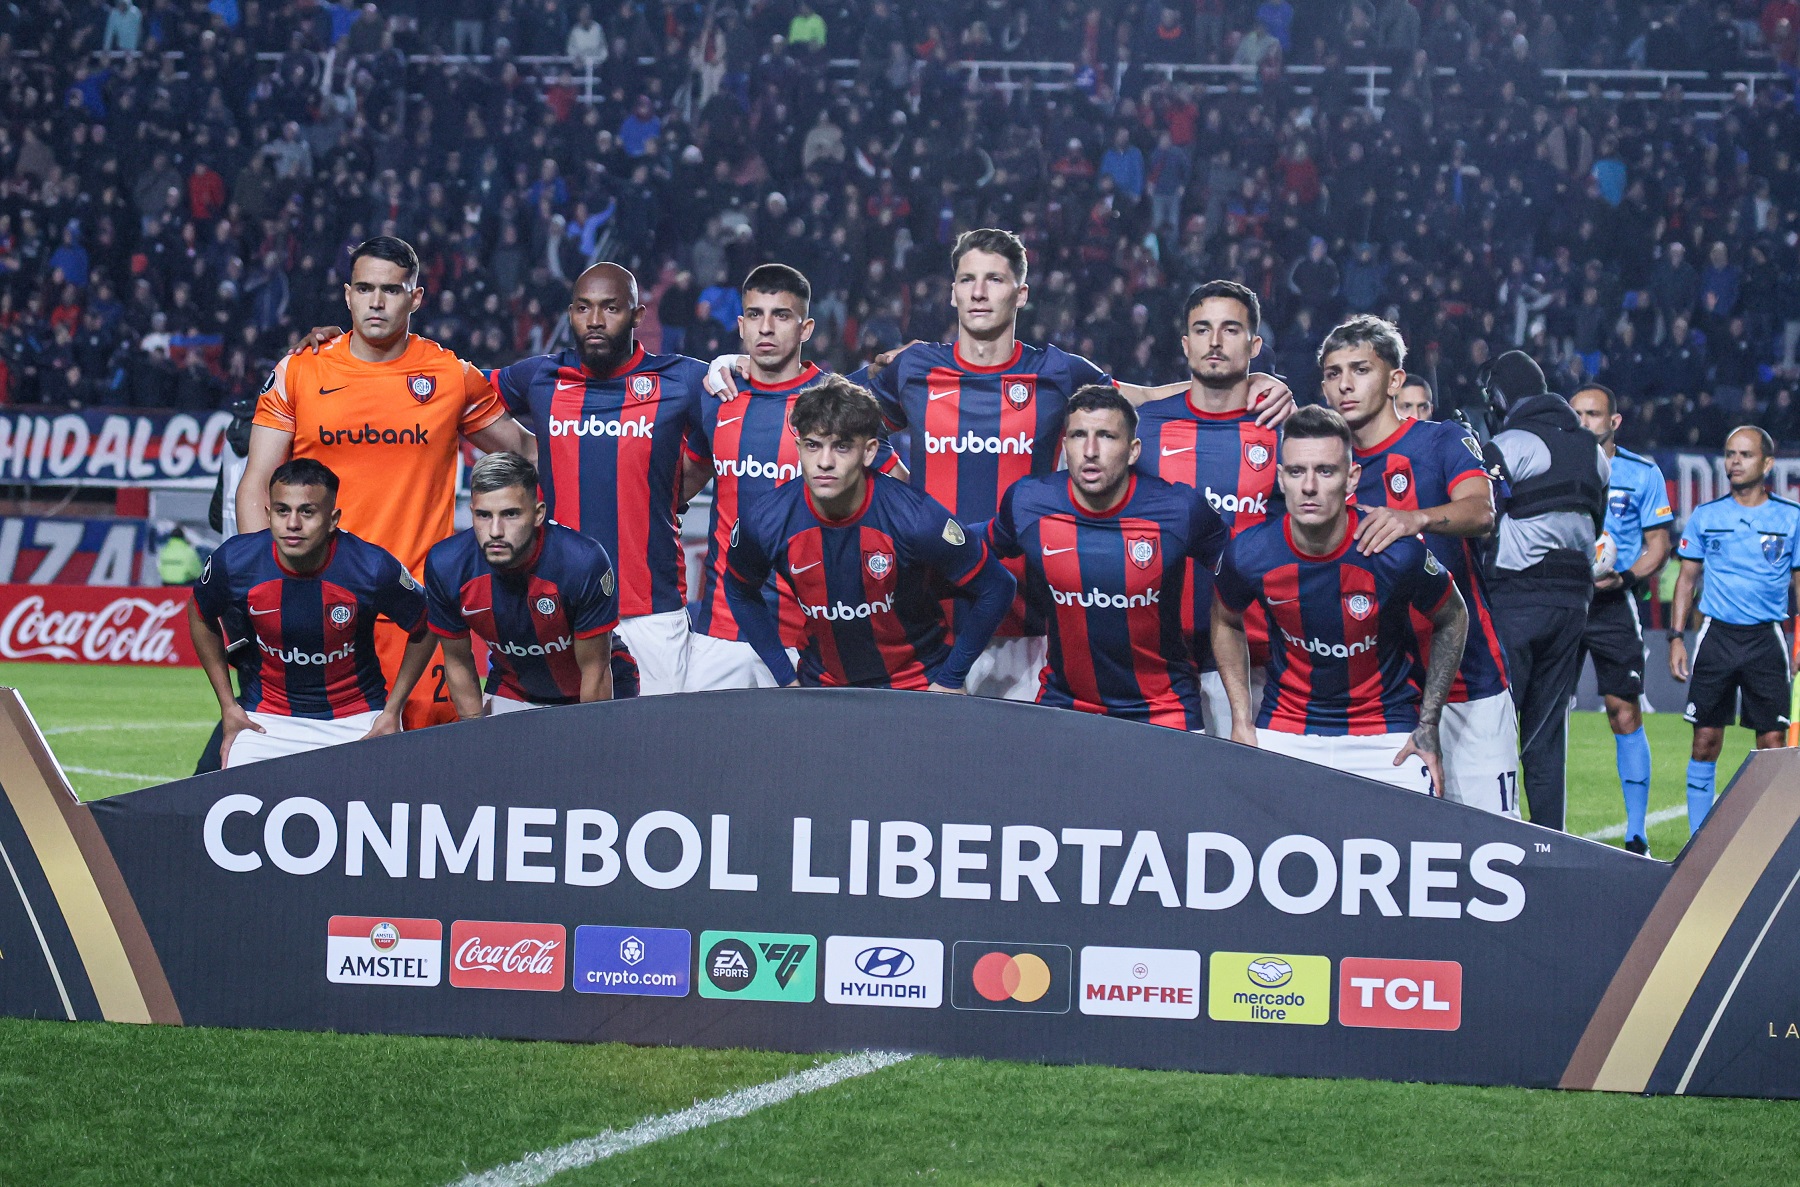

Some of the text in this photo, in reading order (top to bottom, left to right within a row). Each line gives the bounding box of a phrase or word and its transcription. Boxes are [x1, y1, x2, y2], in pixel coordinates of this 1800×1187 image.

[319, 423, 429, 446] brubank
[549, 414, 654, 439] brubank
[924, 430, 1034, 455] brubank
[1205, 486, 1268, 514] bank
[797, 592, 894, 621] brubank
[1048, 584, 1160, 609] brubank
[0, 595, 187, 663] Coca-Cola
[256, 633, 355, 666] brubank
[486, 635, 572, 657] rubank
[1280, 627, 1377, 658] brubank
[1497, 770, 1516, 812] 17
[203, 793, 758, 892] CONMEBOL
[791, 816, 1526, 922] LIBERTADORES
[339, 956, 428, 979] AMSTEL
[454, 936, 561, 975] Coca-Cola
[713, 949, 748, 969] EA
[586, 969, 677, 986] crypto.com
[713, 967, 749, 978] SPORTS
[840, 982, 926, 999] HYUNDAI
[1086, 983, 1193, 1005] MAPFRE
[1233, 992, 1305, 1007] mercado
[1350, 977, 1450, 1011] TCL
[1251, 1006, 1287, 1020] libre
